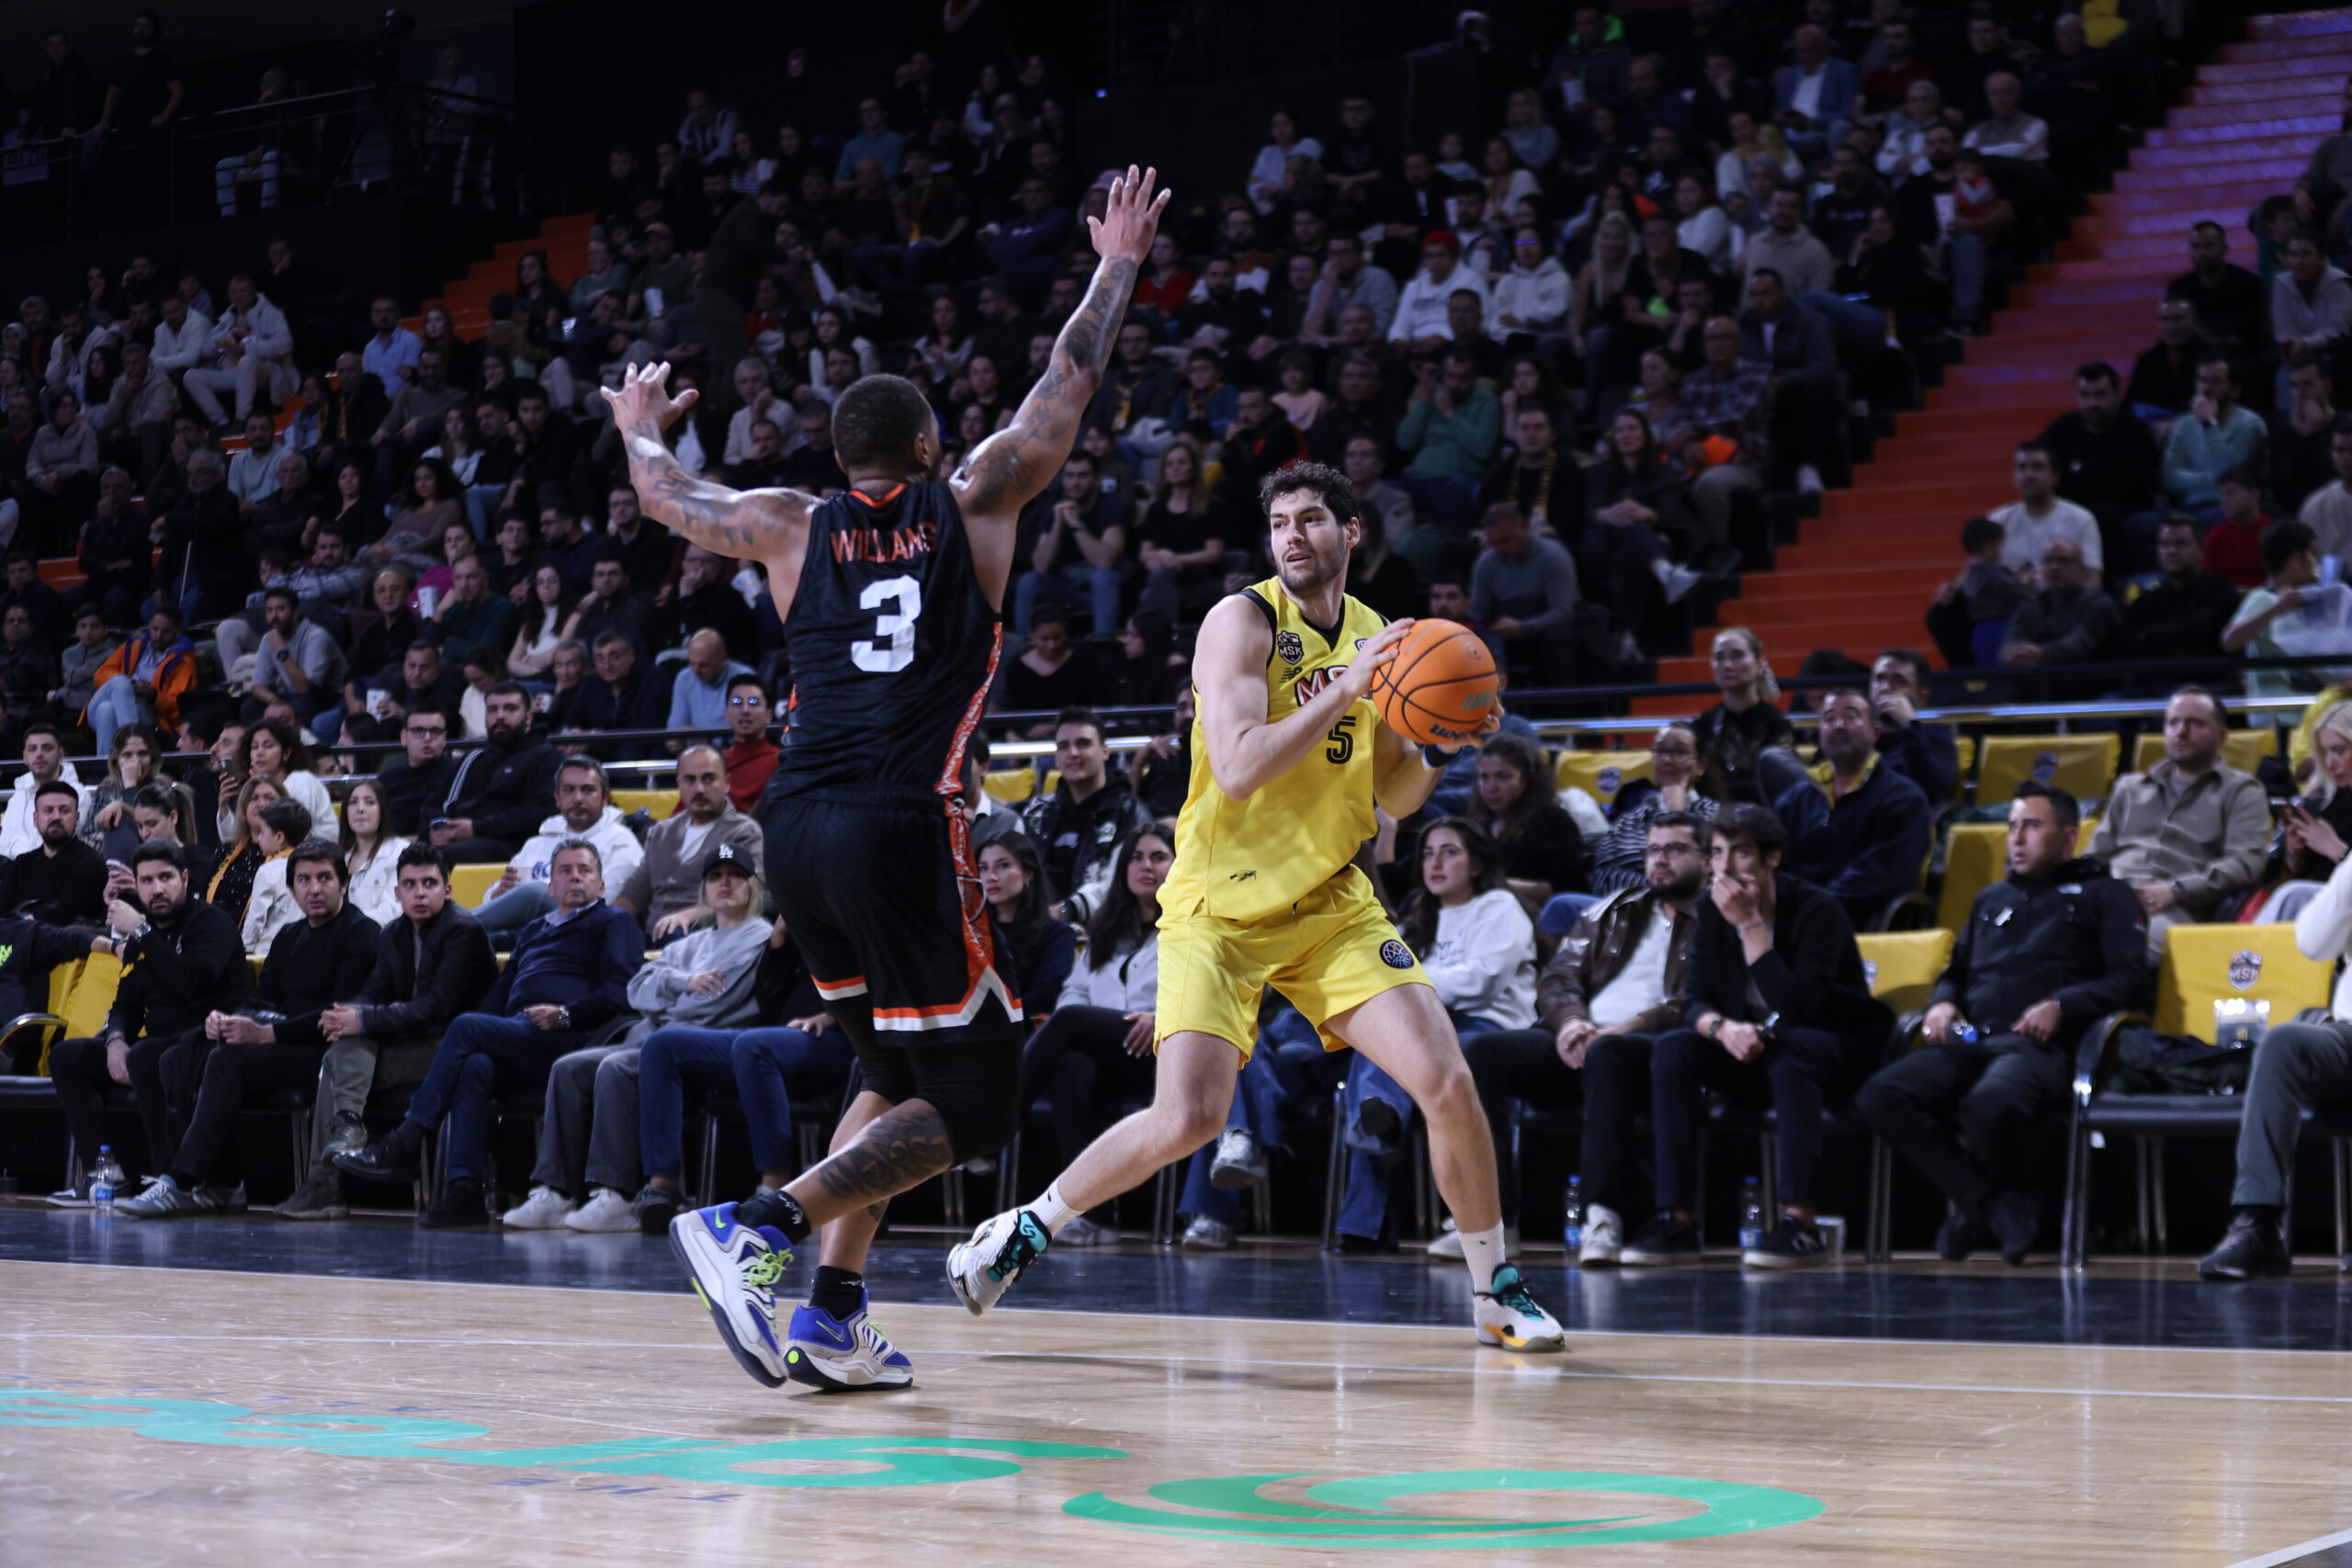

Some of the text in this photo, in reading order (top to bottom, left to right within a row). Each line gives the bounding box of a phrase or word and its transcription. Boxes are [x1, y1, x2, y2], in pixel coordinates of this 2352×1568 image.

[851, 574, 922, 672] 3
[1326, 716, 1357, 764] 5
[718, 843, 734, 859] LA
